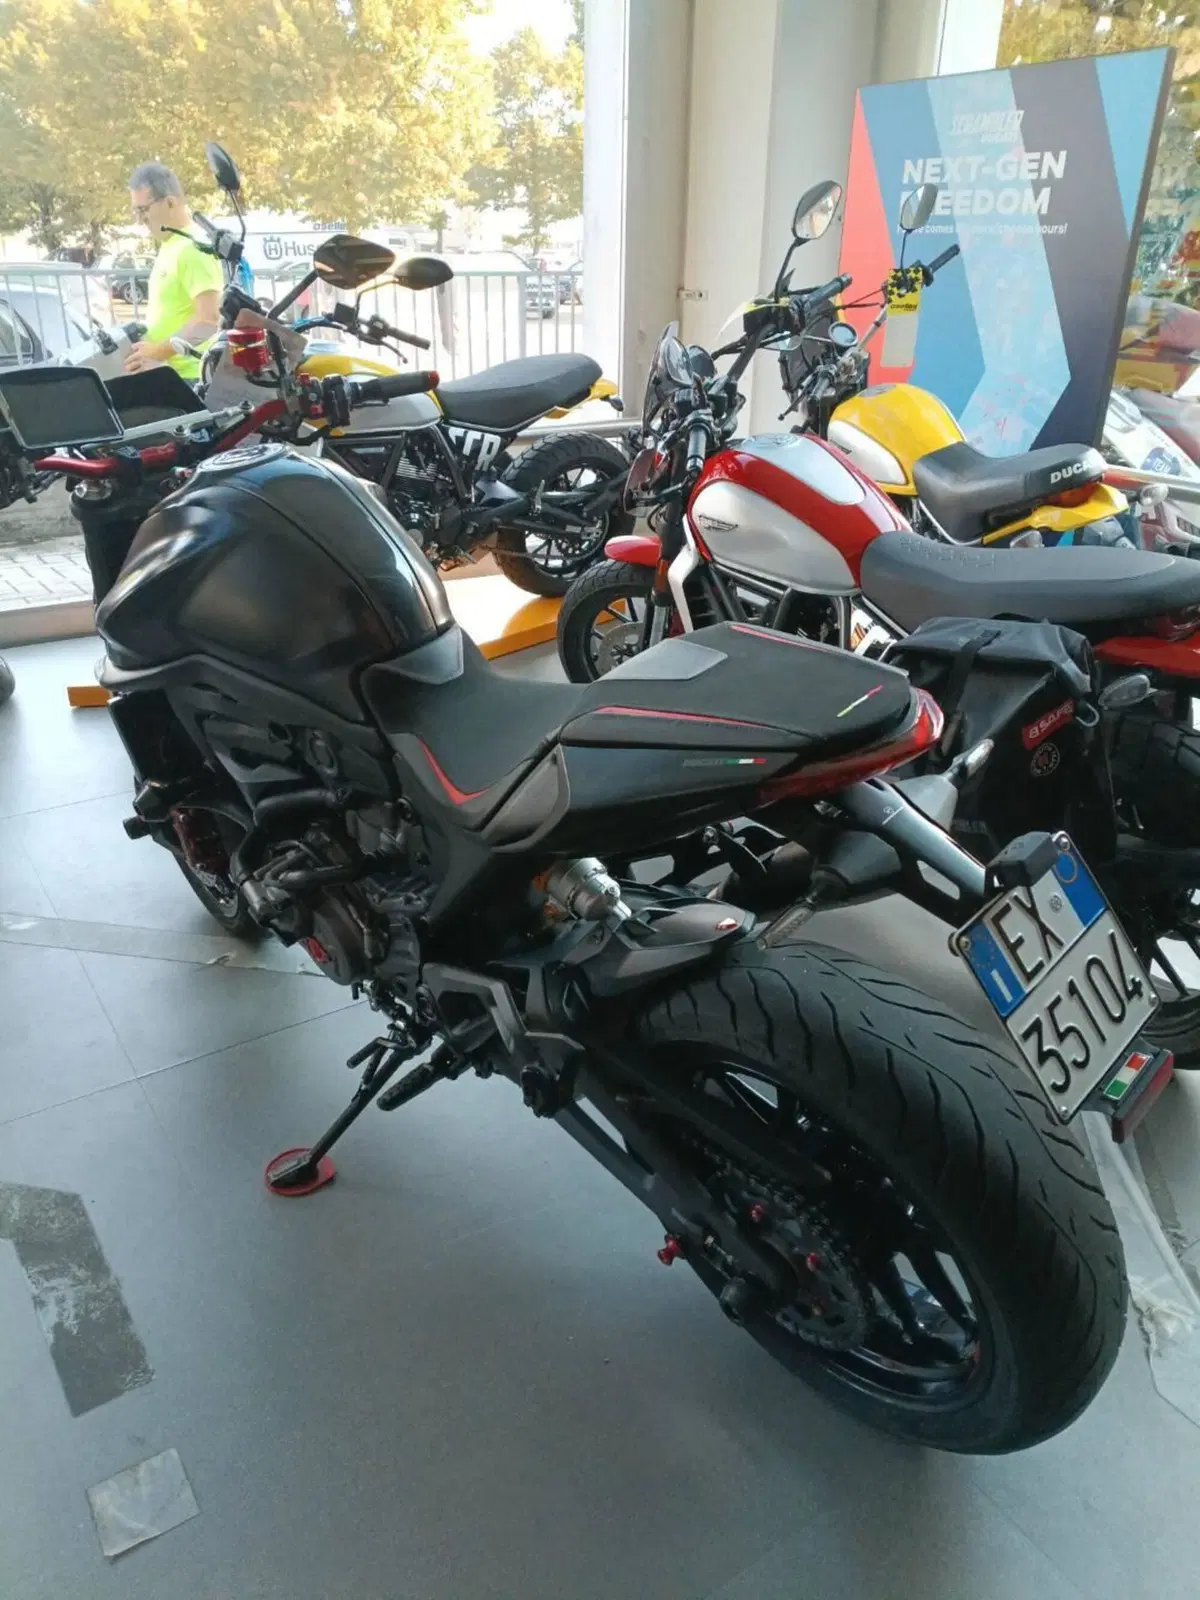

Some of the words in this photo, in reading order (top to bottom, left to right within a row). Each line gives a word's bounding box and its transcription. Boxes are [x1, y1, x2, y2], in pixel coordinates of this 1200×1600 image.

[902, 151, 1067, 184] NEXT-GEN
[900, 187, 1051, 216] FEEDOM
[285, 240, 319, 257] Hus
[991, 886, 1064, 985] EX
[1020, 929, 1144, 1095] 35104
